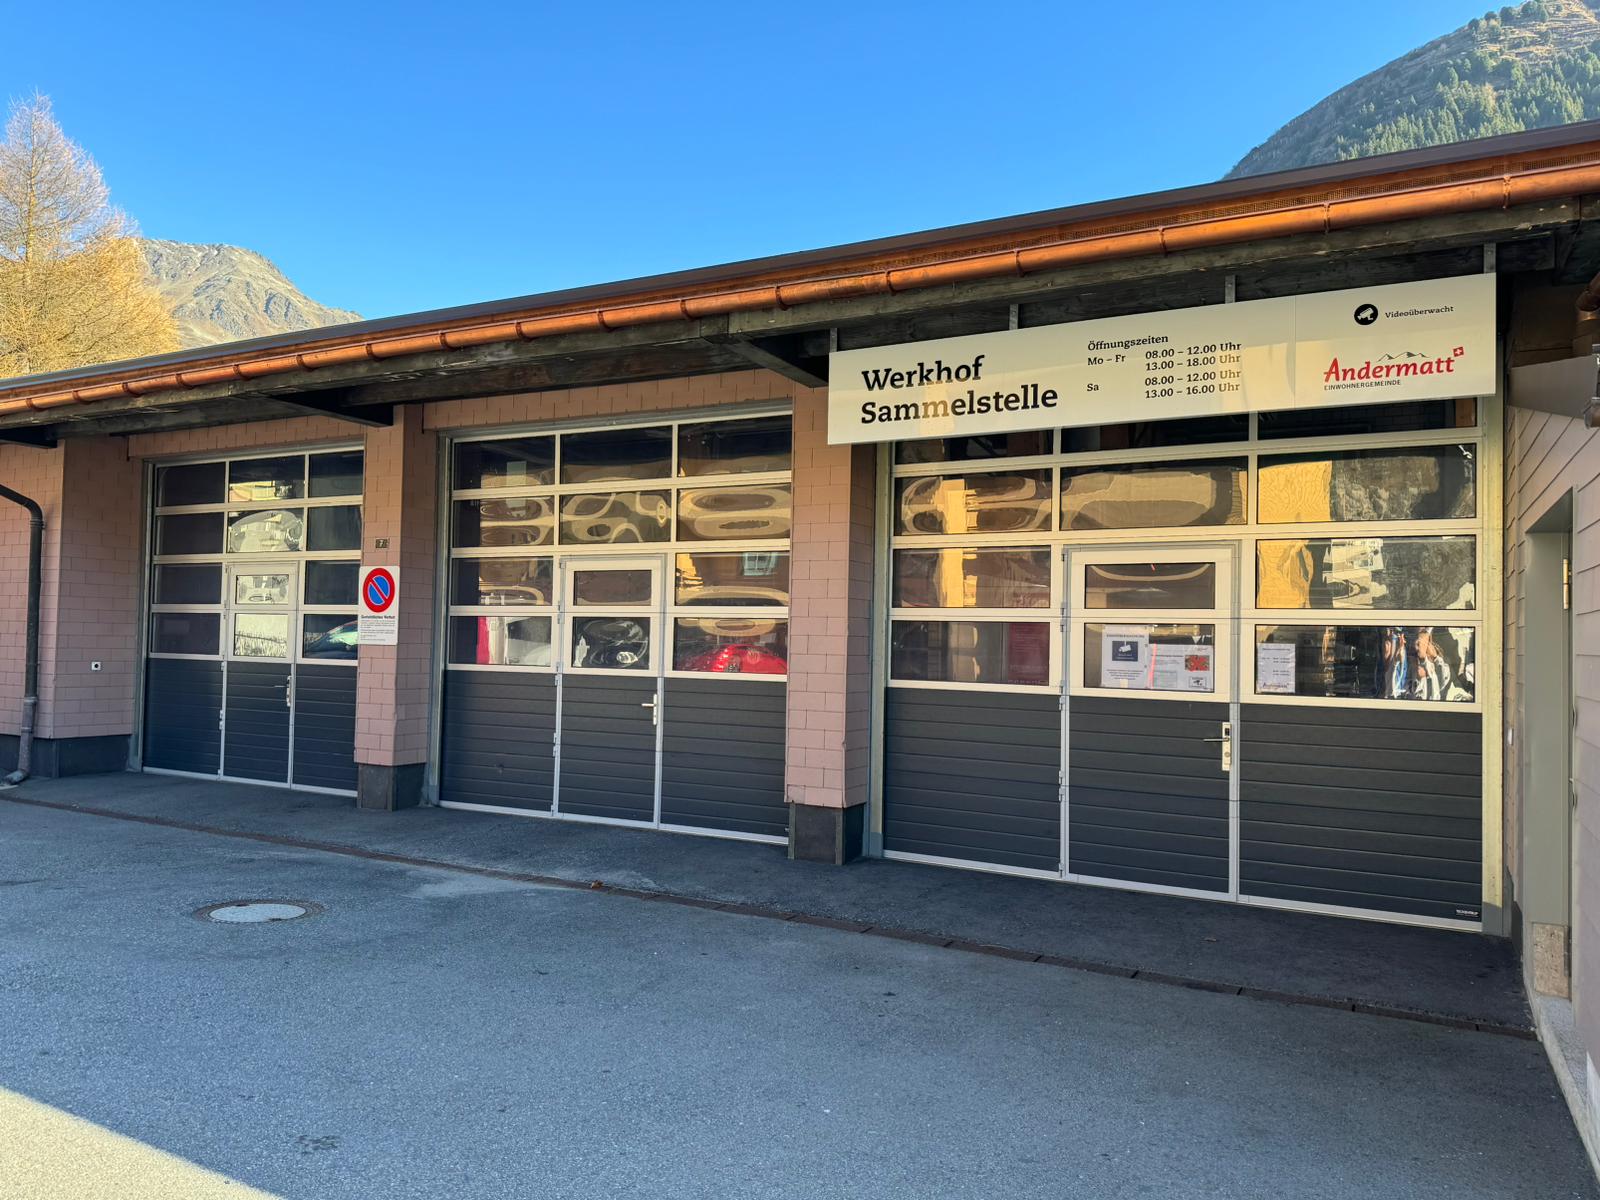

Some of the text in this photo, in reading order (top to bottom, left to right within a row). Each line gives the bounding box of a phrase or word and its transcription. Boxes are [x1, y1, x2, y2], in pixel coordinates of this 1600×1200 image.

[1384, 305, 1454, 319] Videoüberwacht
[1088, 335, 1169, 352] Öffnungszeiten
[1088, 357, 1103, 366] Mo
[1115, 354, 1126, 363] Fr
[1145, 348, 1174, 360] 08.00
[1187, 344, 1216, 355] 12.00
[1220, 342, 1241, 352] Uhr
[1146, 360, 1174, 371] 13.00
[1187, 356, 1216, 367] 18.00
[1219, 354, 1241, 364] Uhr
[861, 354, 985, 392] Werkhof
[1324, 357, 1455, 383] Andermatt
[1087, 383, 1099, 392] Sa
[1145, 376, 1174, 387] 08.00
[1187, 372, 1216, 382] 12.00
[1220, 369, 1241, 380] Uhr
[1145, 388, 1173, 399] 13.00
[1187, 384, 1215, 395] 16.00
[1218, 382, 1240, 392] Uhr
[1324, 379, 1401, 390] EINWOHNERGEMEINDE
[861, 383, 1058, 424] Sammelstelle
